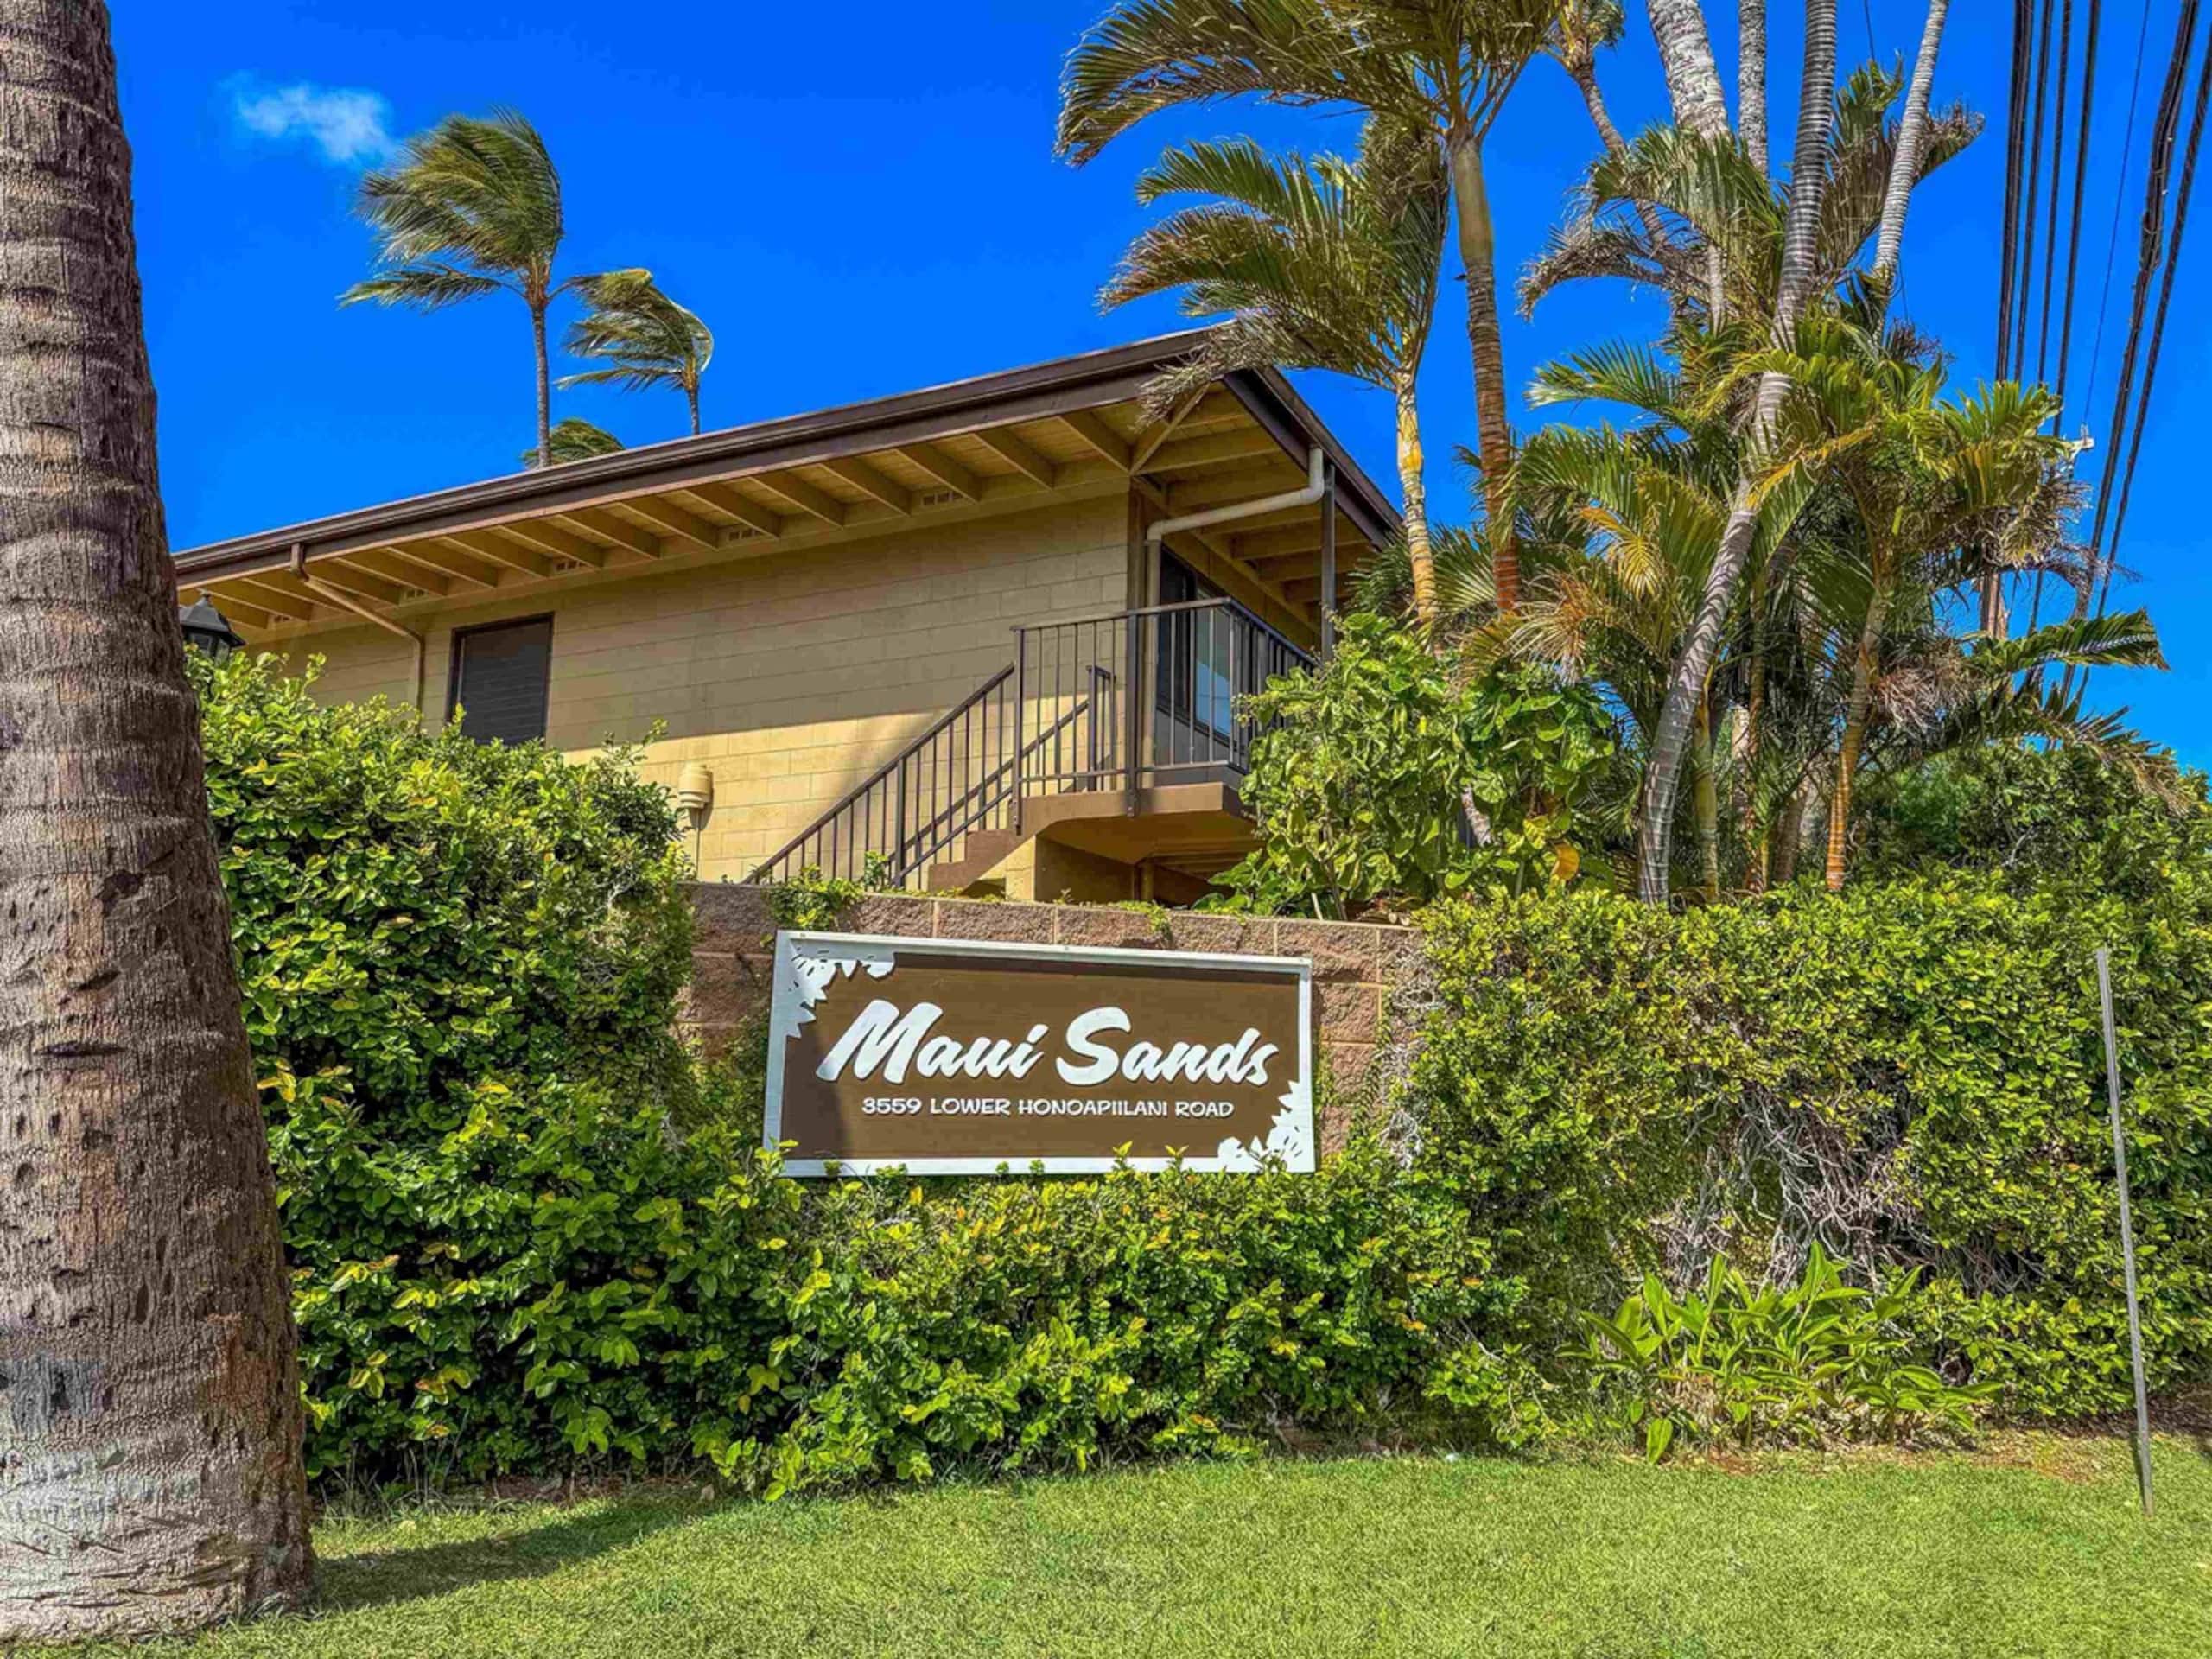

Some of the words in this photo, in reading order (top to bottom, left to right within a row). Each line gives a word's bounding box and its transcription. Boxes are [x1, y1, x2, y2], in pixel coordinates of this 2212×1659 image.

[817, 999, 1049, 1084] Maui
[1056, 1007, 1279, 1085] Sands
[861, 1097, 922, 1115] 3559
[930, 1098, 1010, 1116] LOWER
[1018, 1099, 1168, 1116] HONOAPIILANI
[1174, 1101, 1234, 1117] ROAD
